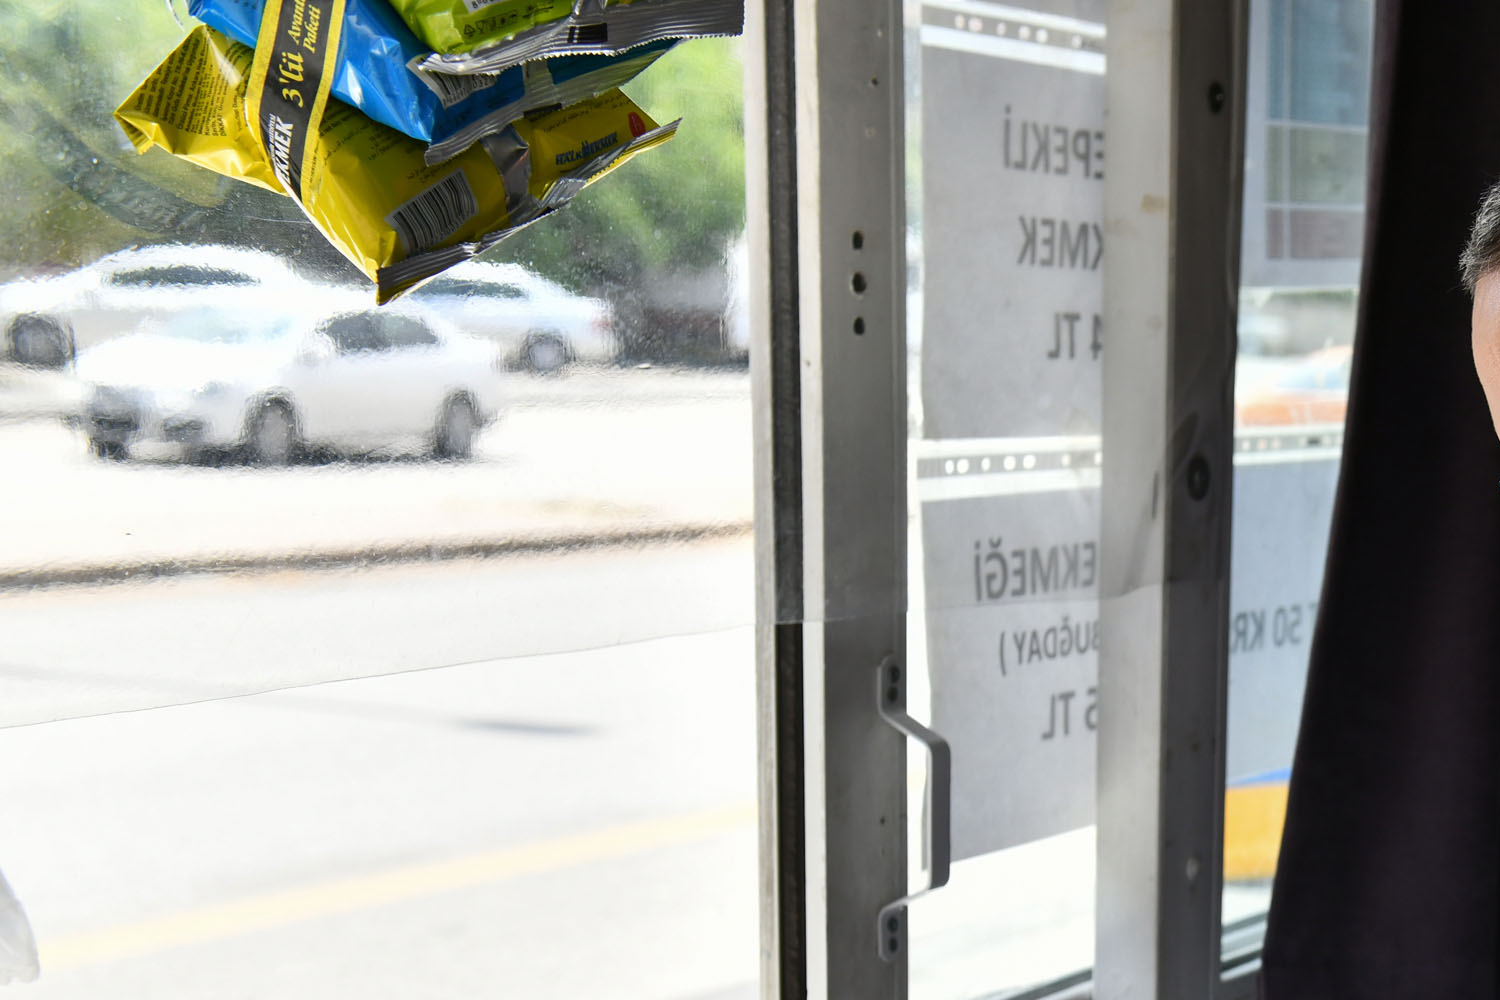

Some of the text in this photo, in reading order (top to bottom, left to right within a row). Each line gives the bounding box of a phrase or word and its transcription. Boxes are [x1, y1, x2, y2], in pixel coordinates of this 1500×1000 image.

[287, 0, 306, 45] Avant
[303, 4, 321, 54] Paketi
[279, 52, 304, 108] 3'lü
